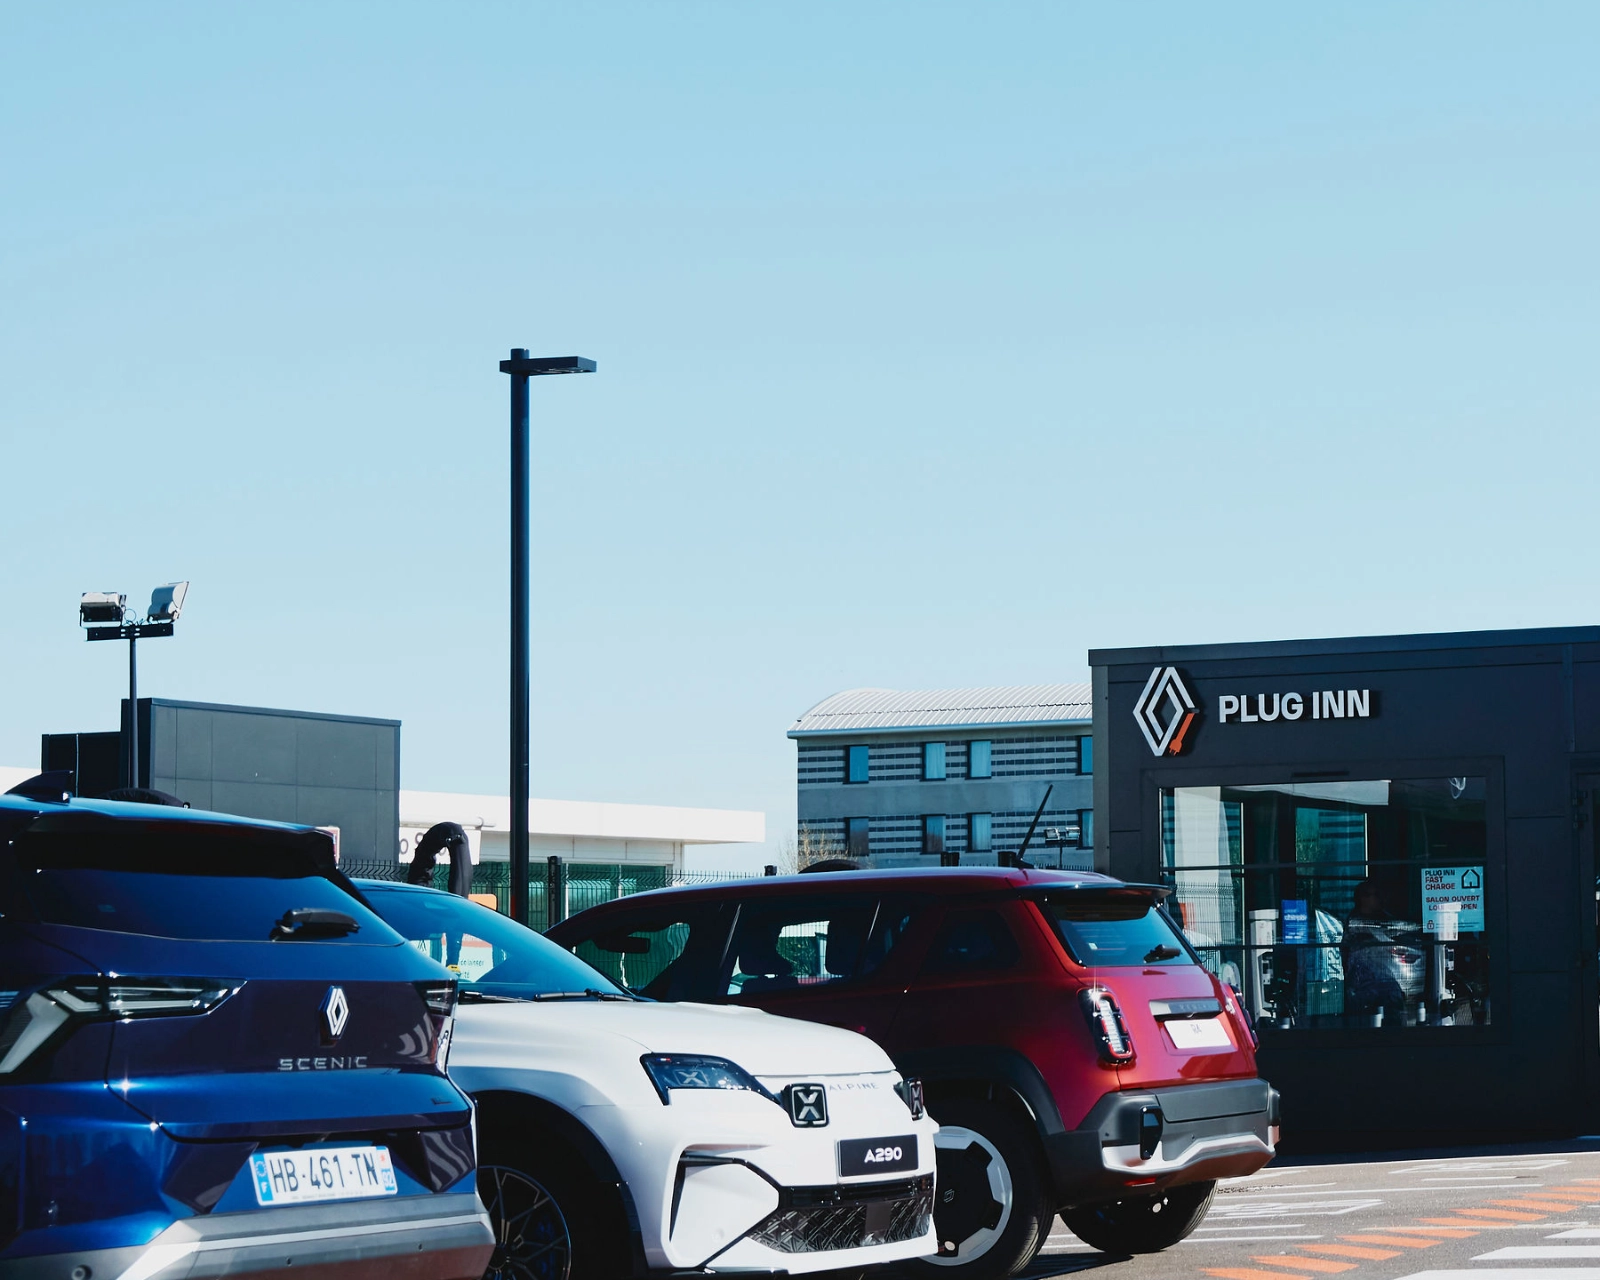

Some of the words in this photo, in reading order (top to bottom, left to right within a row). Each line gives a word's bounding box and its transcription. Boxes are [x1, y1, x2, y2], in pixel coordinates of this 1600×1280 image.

[1218, 692, 1304, 724] PLUG
[1312, 689, 1370, 720] INN
[1425, 869, 1443, 877] PLUG
[1425, 876, 1443, 884] FAST
[1425, 883, 1456, 891] CHARGE
[278, 1056, 368, 1071] SCENIC
[829, 1082, 880, 1091] ALPINE
[864, 1146, 903, 1164] A290
